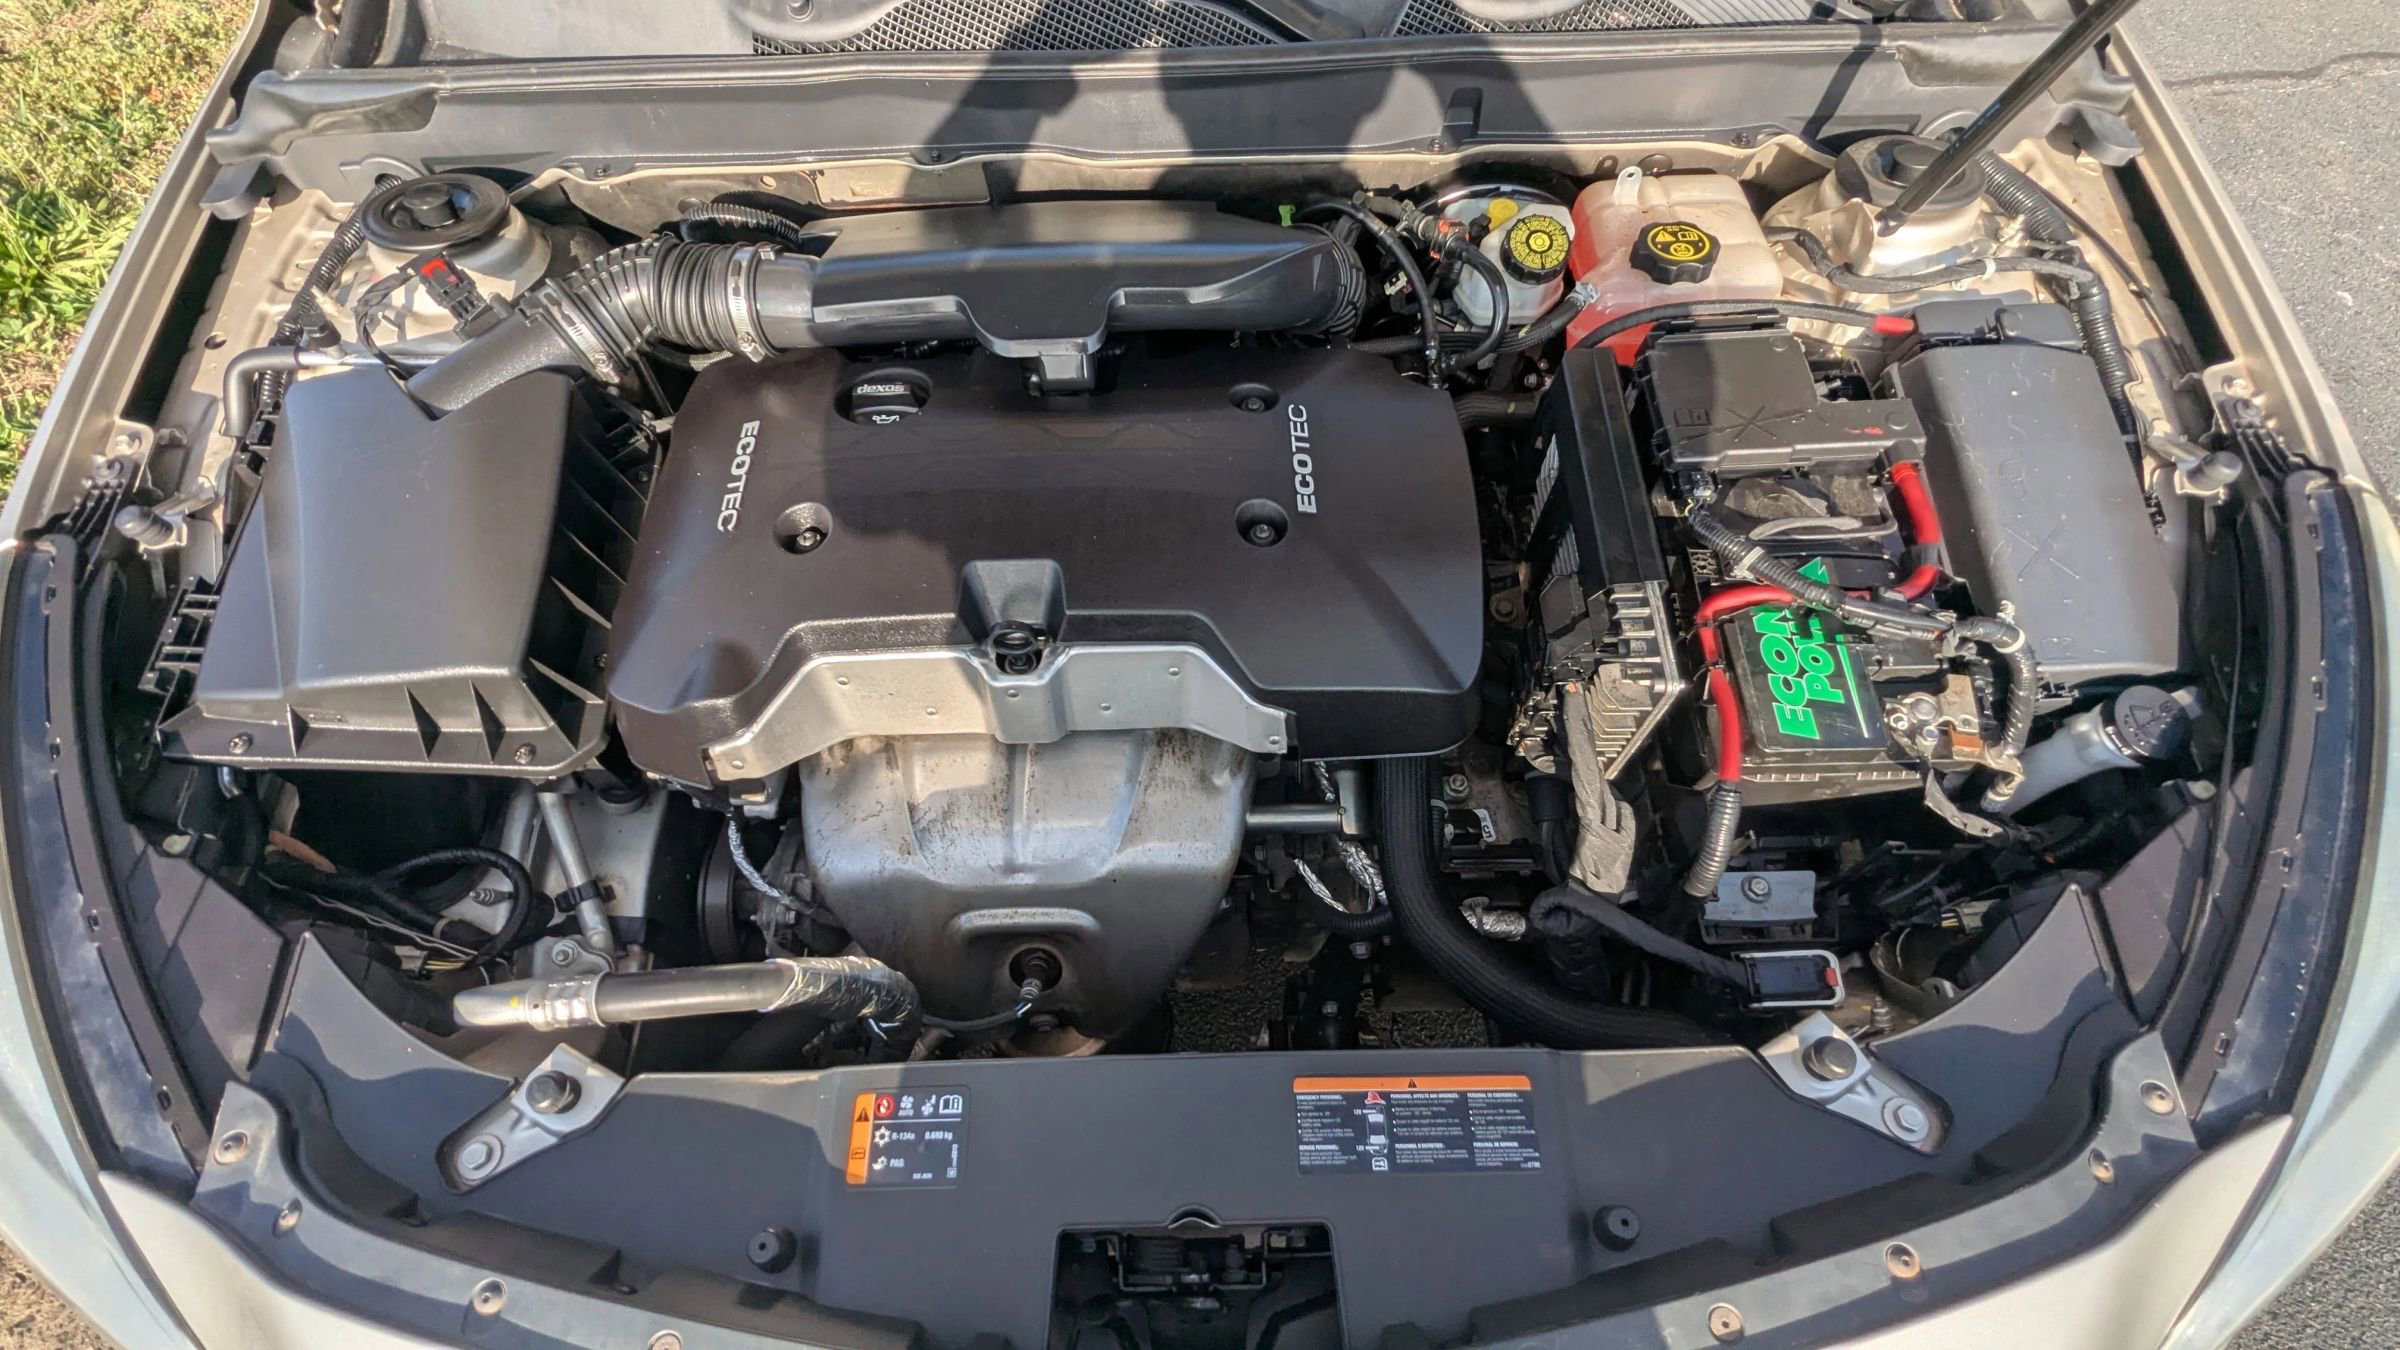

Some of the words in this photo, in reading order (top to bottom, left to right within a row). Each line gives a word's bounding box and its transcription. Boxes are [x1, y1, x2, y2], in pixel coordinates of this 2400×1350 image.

[857, 384, 905, 394] dexos
[717, 420, 760, 533] ECOTEC
[1288, 404, 1317, 513] ECOTEC
[1752, 604, 1820, 740] ECON
[889, 1158, 905, 1168] PAG
